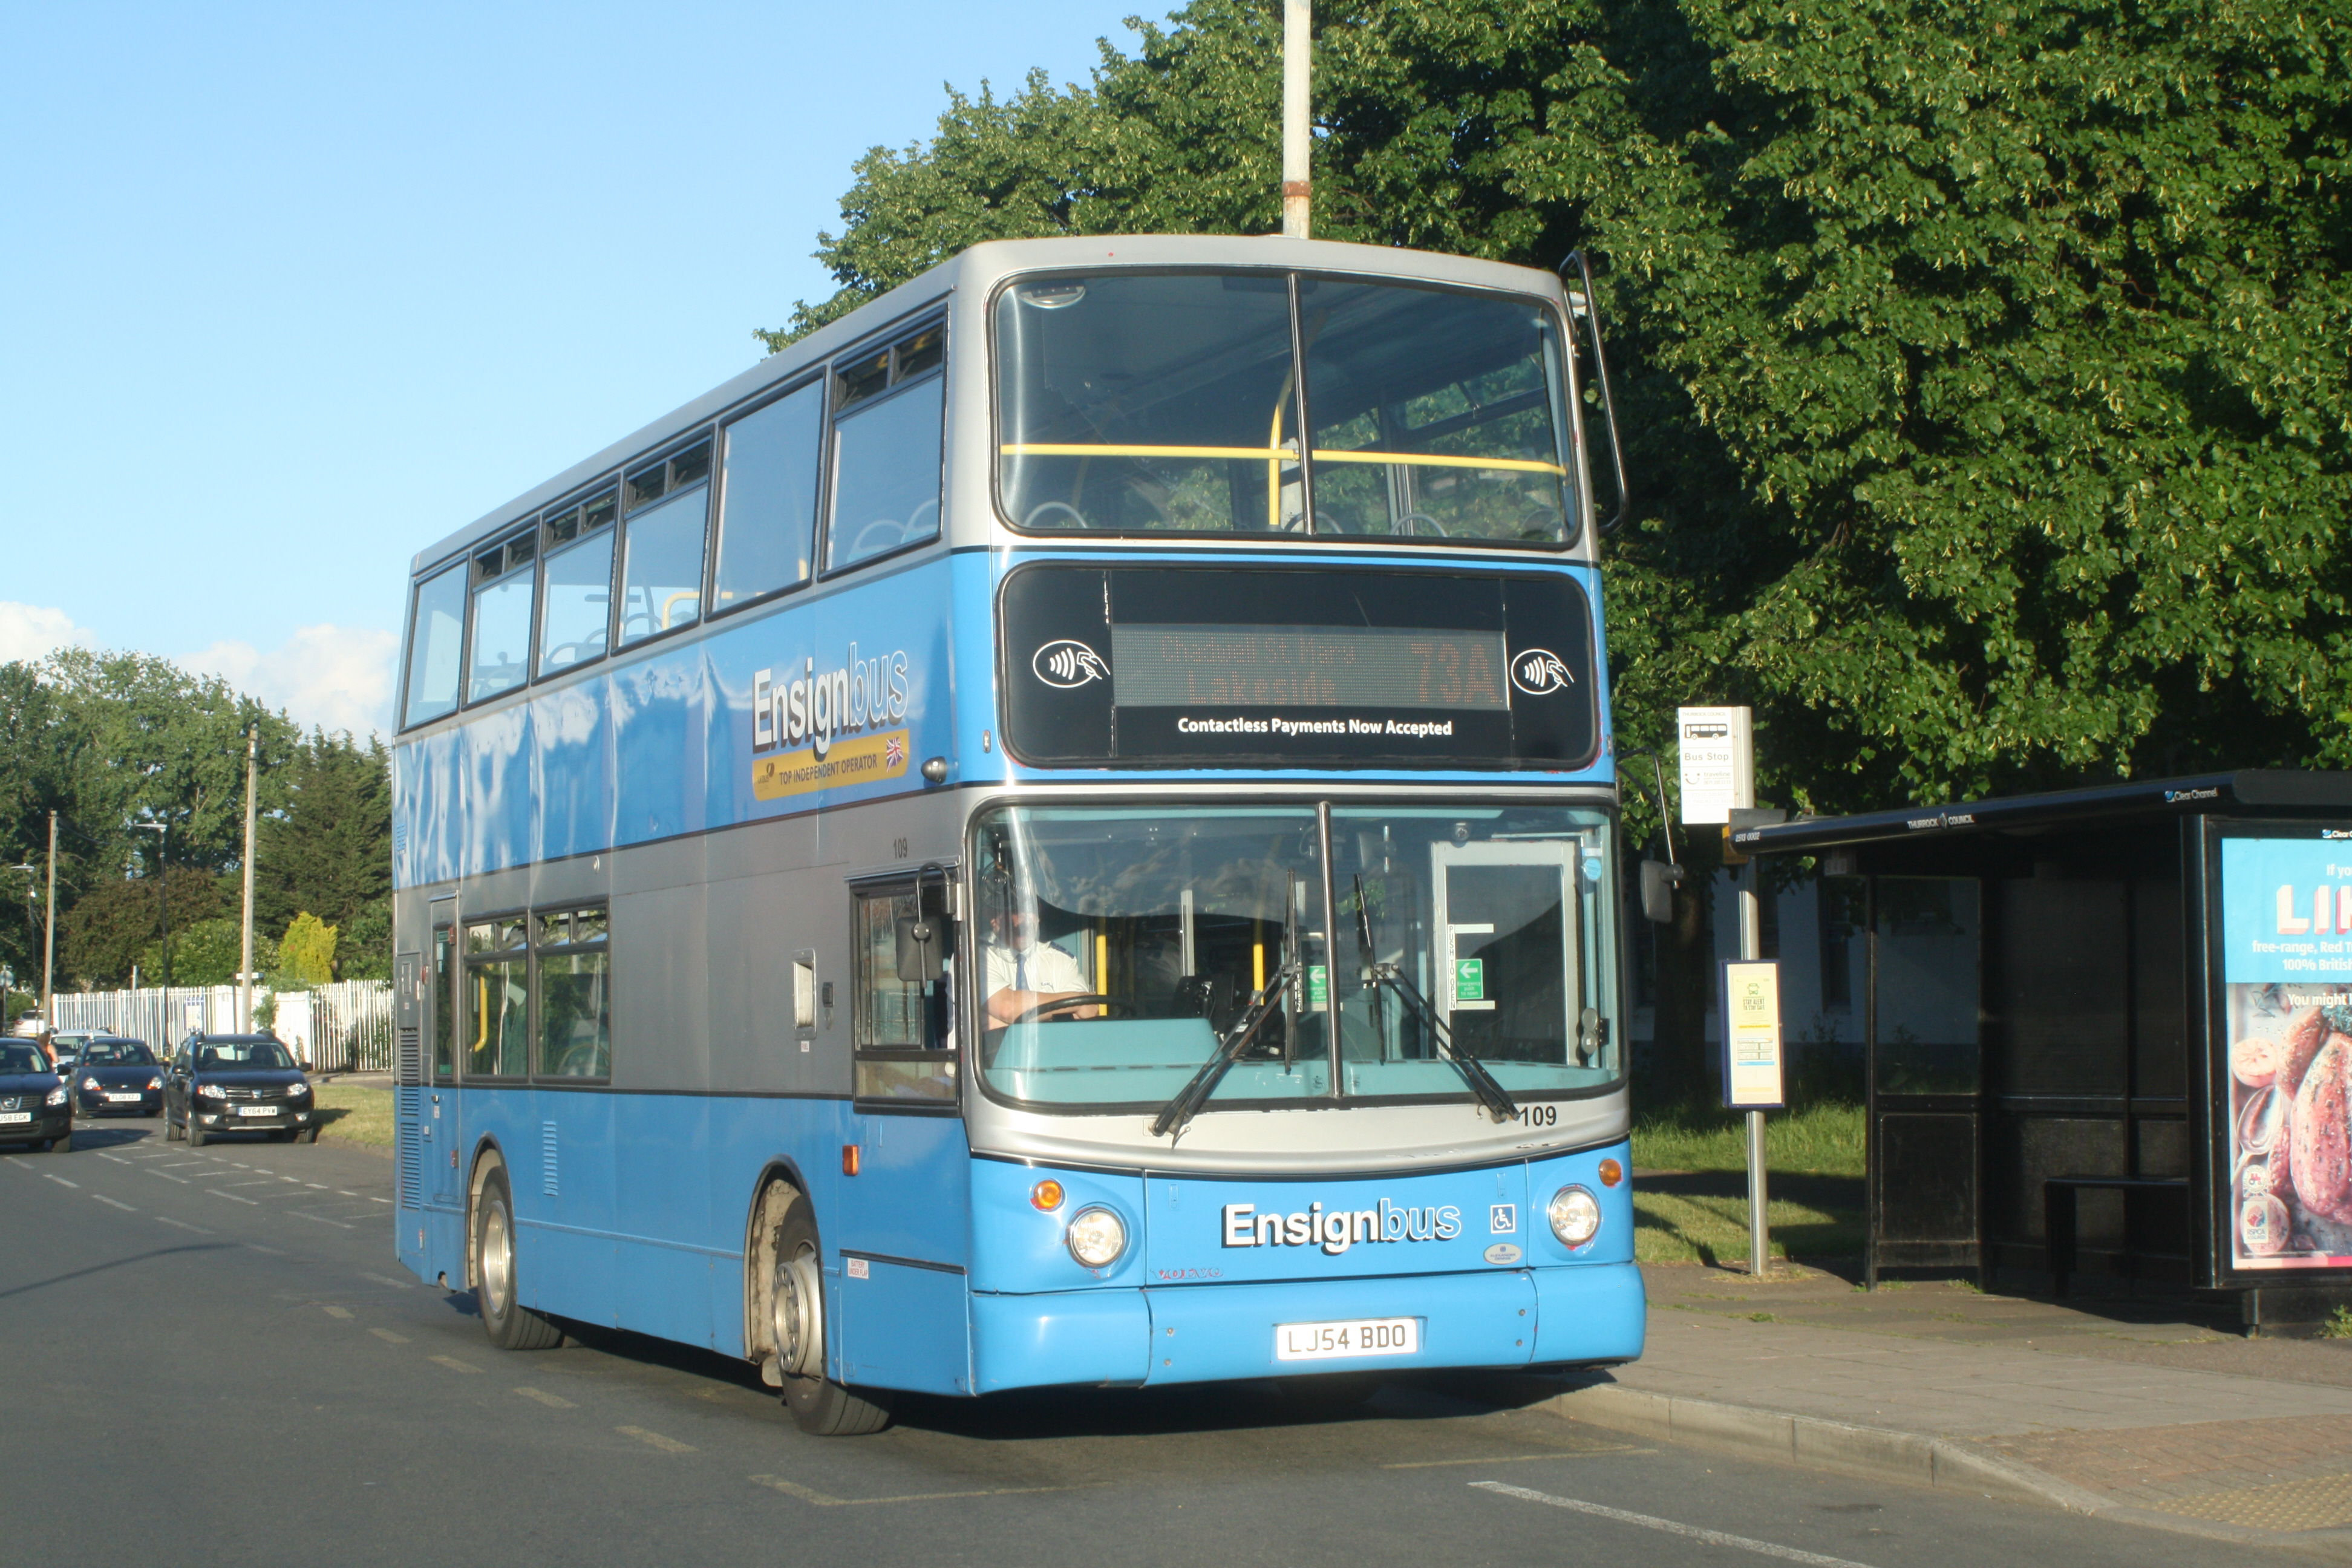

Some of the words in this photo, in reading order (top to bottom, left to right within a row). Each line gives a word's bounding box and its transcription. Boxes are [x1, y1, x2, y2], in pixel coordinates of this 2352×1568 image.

[1410, 642, 1500, 704] 73A
[1187, 670, 1338, 706] Lakeside
[753, 642, 909, 756] Ensignbus
[1178, 717, 1269, 733] Contactless
[1272, 718, 1346, 736] Payments
[1348, 719, 1382, 734] Now
[1385, 720, 1452, 738] Accepted
[1684, 753, 1704, 761] Bus
[1707, 752, 1729, 762] Stop
[779, 771, 792, 785] TOP
[794, 761, 840, 783] INDEPENDENT
[841, 754, 878, 774] OPERATOR
[2174, 790, 2191, 801] Clear
[2191, 787, 2218, 799] Channel
[1907, 818, 1939, 829] THURROCK
[1948, 814, 1975, 825] COUNCIL
[2331, 830, 2349, 838] Clear
[893, 837, 907, 859] 109
[2326, 863, 2336, 876] If
[2337, 866, 2352, 880] yo
[2252, 940, 2319, 956] free-range,
[2320, 941, 2344, 953] Red
[1449, 960, 1455, 975] TO
[2282, 959, 2317, 970] 100%
[2287, 993, 2310, 1005] You
[2311, 993, 2347, 1008] might
[1520, 1105, 1557, 1126] 109
[1224, 1197, 1462, 1254] Ensignbus
[851, 1259, 865, 1268] BATTERY
[1288, 1327, 1350, 1353] LJ54
[1360, 1324, 1405, 1349] BDO
